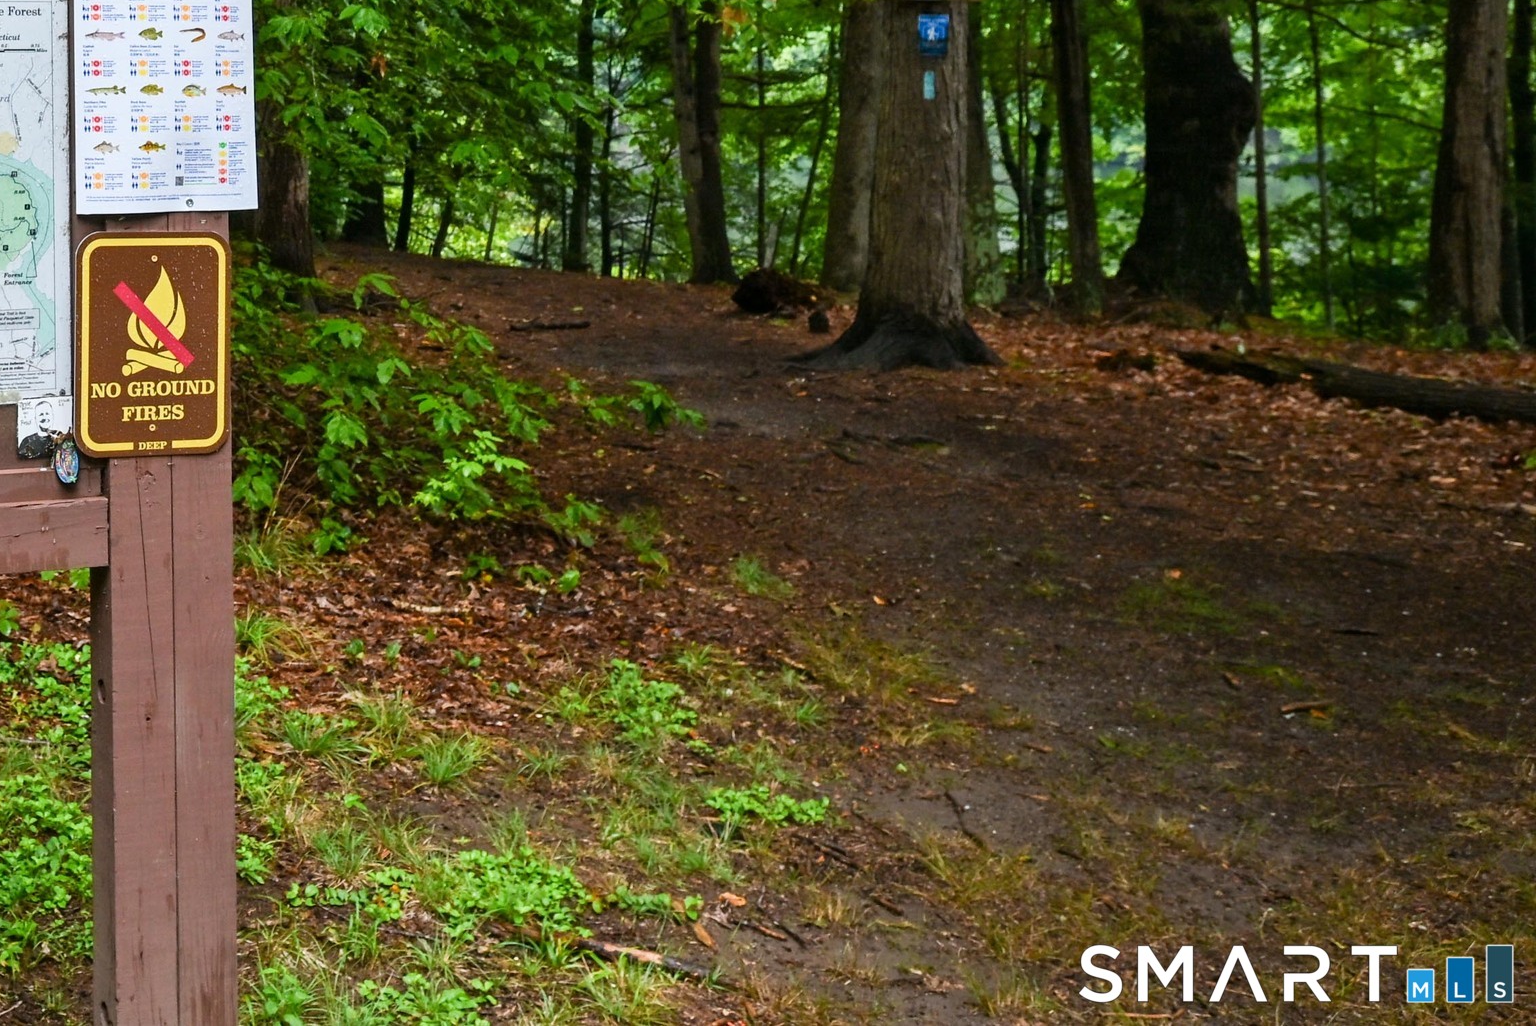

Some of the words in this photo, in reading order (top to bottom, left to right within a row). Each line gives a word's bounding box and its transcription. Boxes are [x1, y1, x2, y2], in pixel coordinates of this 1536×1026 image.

[8, 6, 41, 16] Forest
[91, 383, 121, 398] NO
[127, 380, 215, 397] GROUND
[122, 405, 184, 422] FIRES
[138, 441, 167, 450] DEEP
